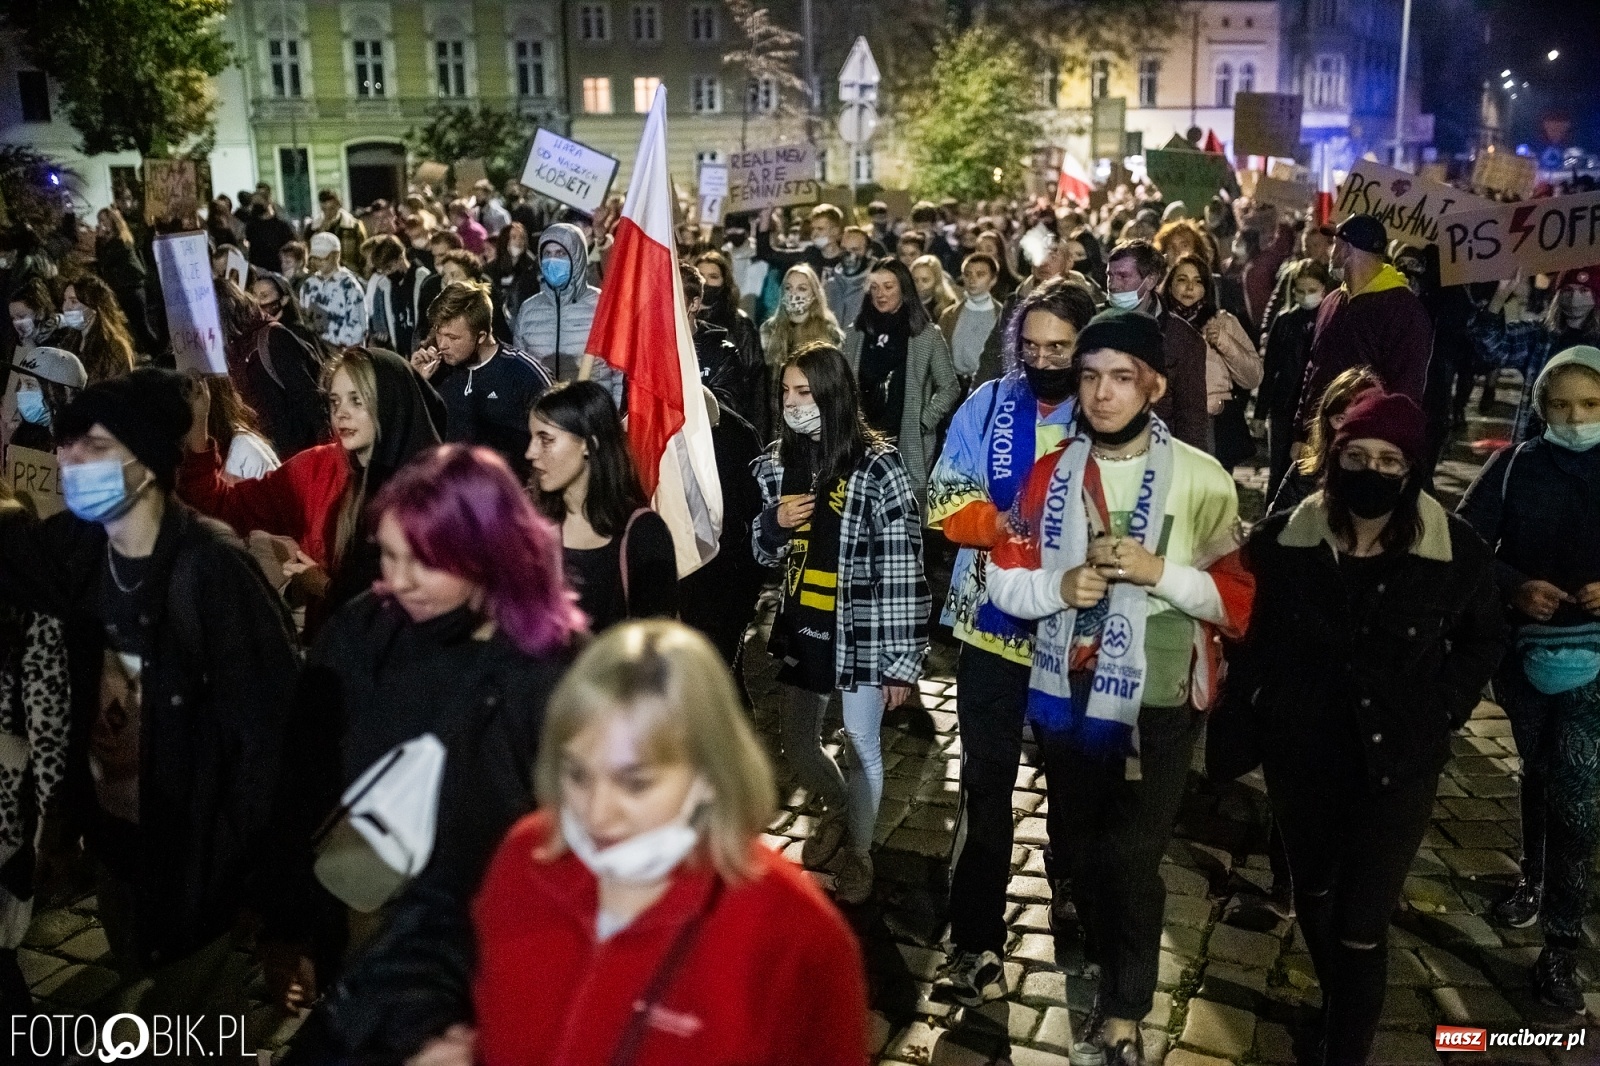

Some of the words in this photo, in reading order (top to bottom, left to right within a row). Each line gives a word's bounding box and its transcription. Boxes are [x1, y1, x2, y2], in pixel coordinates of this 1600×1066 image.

[730, 150, 773, 169] REAL
[747, 166, 787, 183] ARE
[730, 179, 817, 203] FEMINISTS
[1445, 219, 1501, 263] PiS
[1539, 204, 1600, 251] OFF
[993, 400, 1016, 480] POKORA
[1092, 674, 1140, 700] onar
